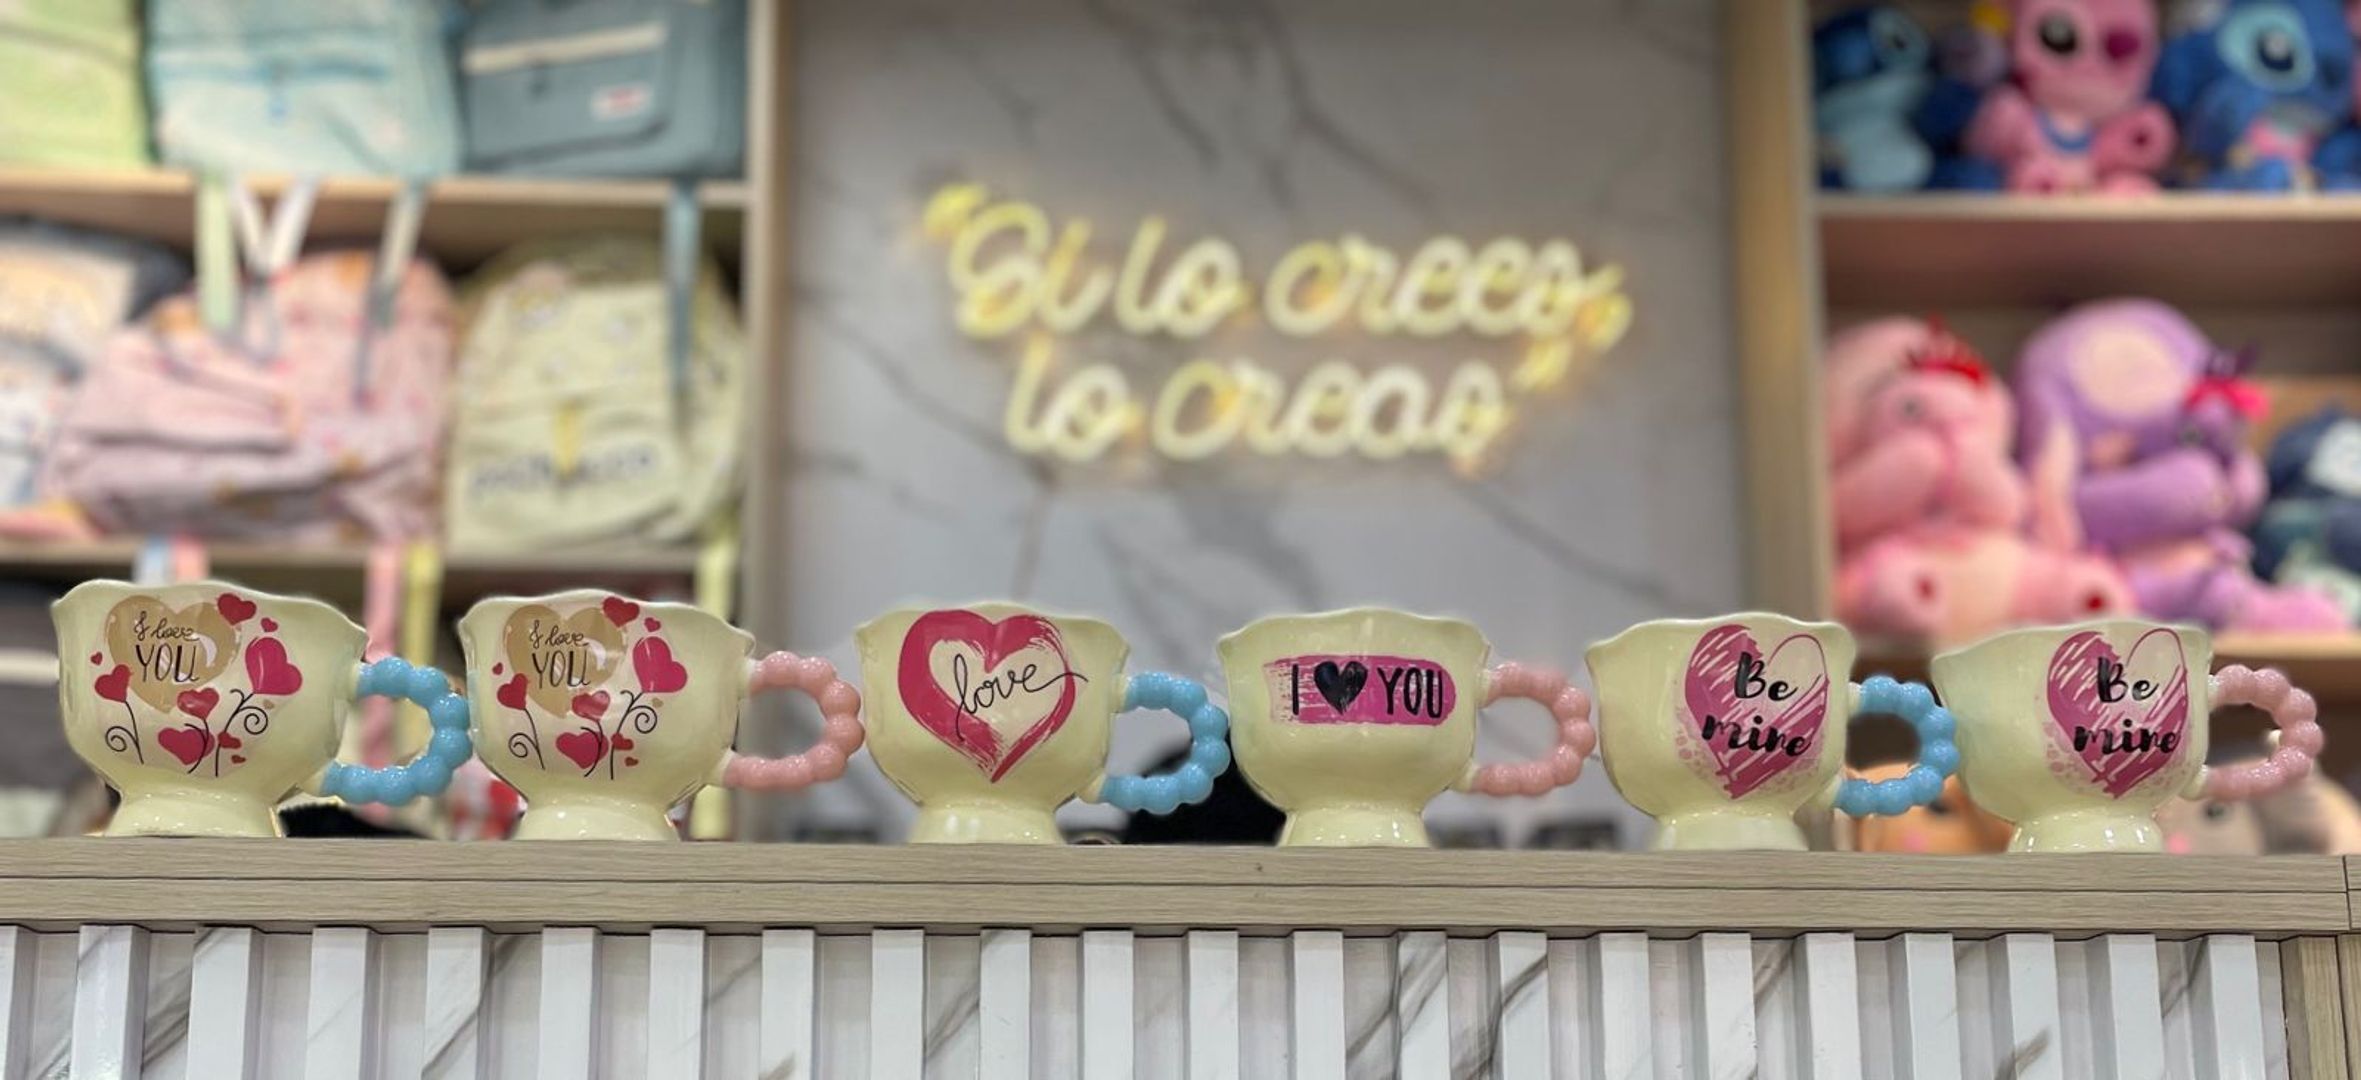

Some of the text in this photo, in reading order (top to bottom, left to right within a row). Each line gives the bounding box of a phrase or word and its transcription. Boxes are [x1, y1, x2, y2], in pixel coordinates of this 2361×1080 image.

[544, 624, 590, 648] love
[135, 643, 200, 683] YOU
[531, 649, 592, 690] YOU
[1733, 651, 1798, 701] Be
[2096, 656, 2159, 703] Be
[953, 653, 1089, 742] love
[1291, 663, 1443, 719] I YOU
[1701, 714, 1812, 757] mine
[2073, 718, 2183, 755] mine
